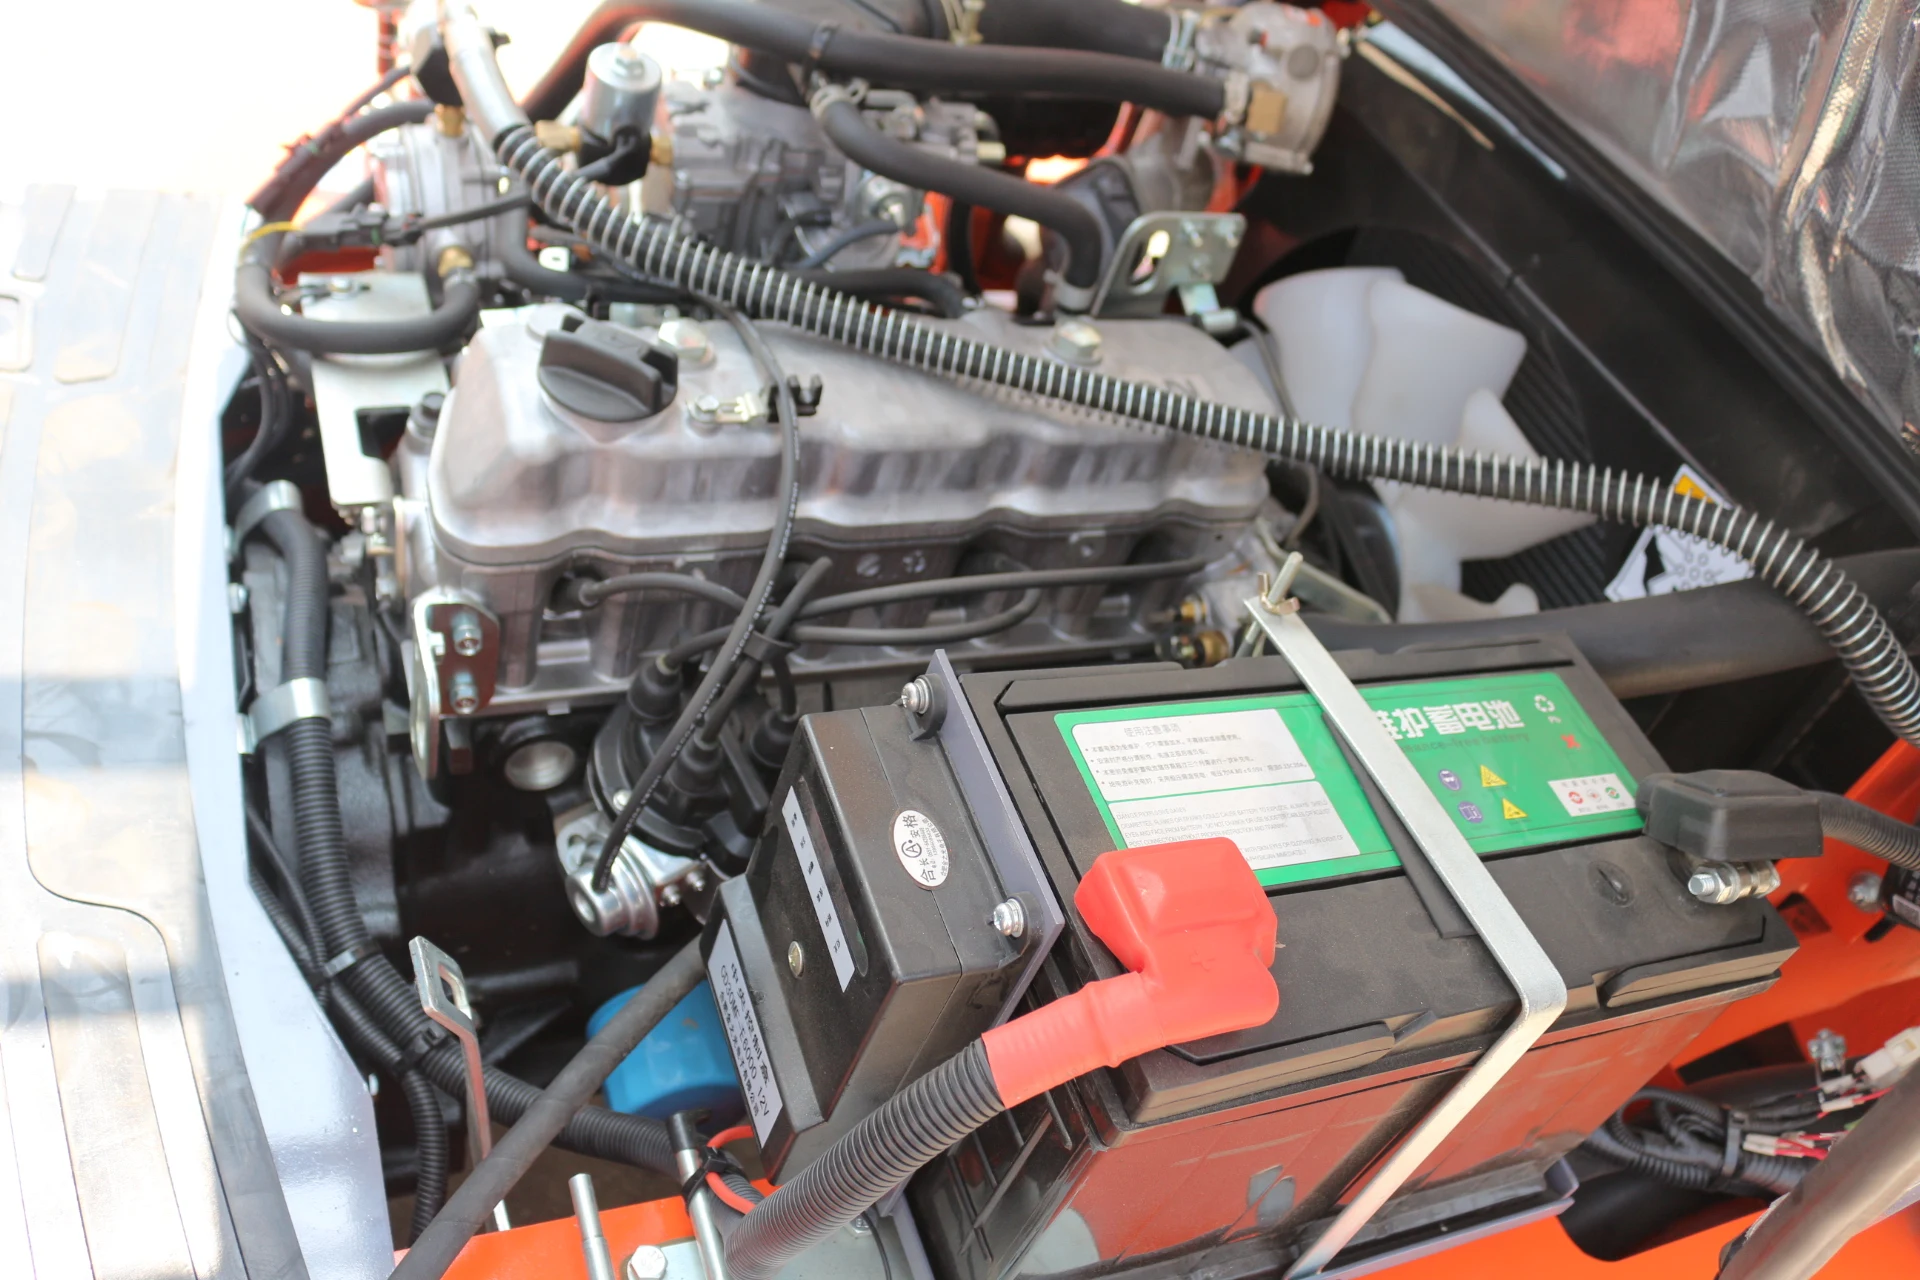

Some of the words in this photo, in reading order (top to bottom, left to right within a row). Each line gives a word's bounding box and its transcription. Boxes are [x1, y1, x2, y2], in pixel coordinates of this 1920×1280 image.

[1124, 722, 1182, 737] 使用注意事项
[758, 1087, 770, 1117] 12V
